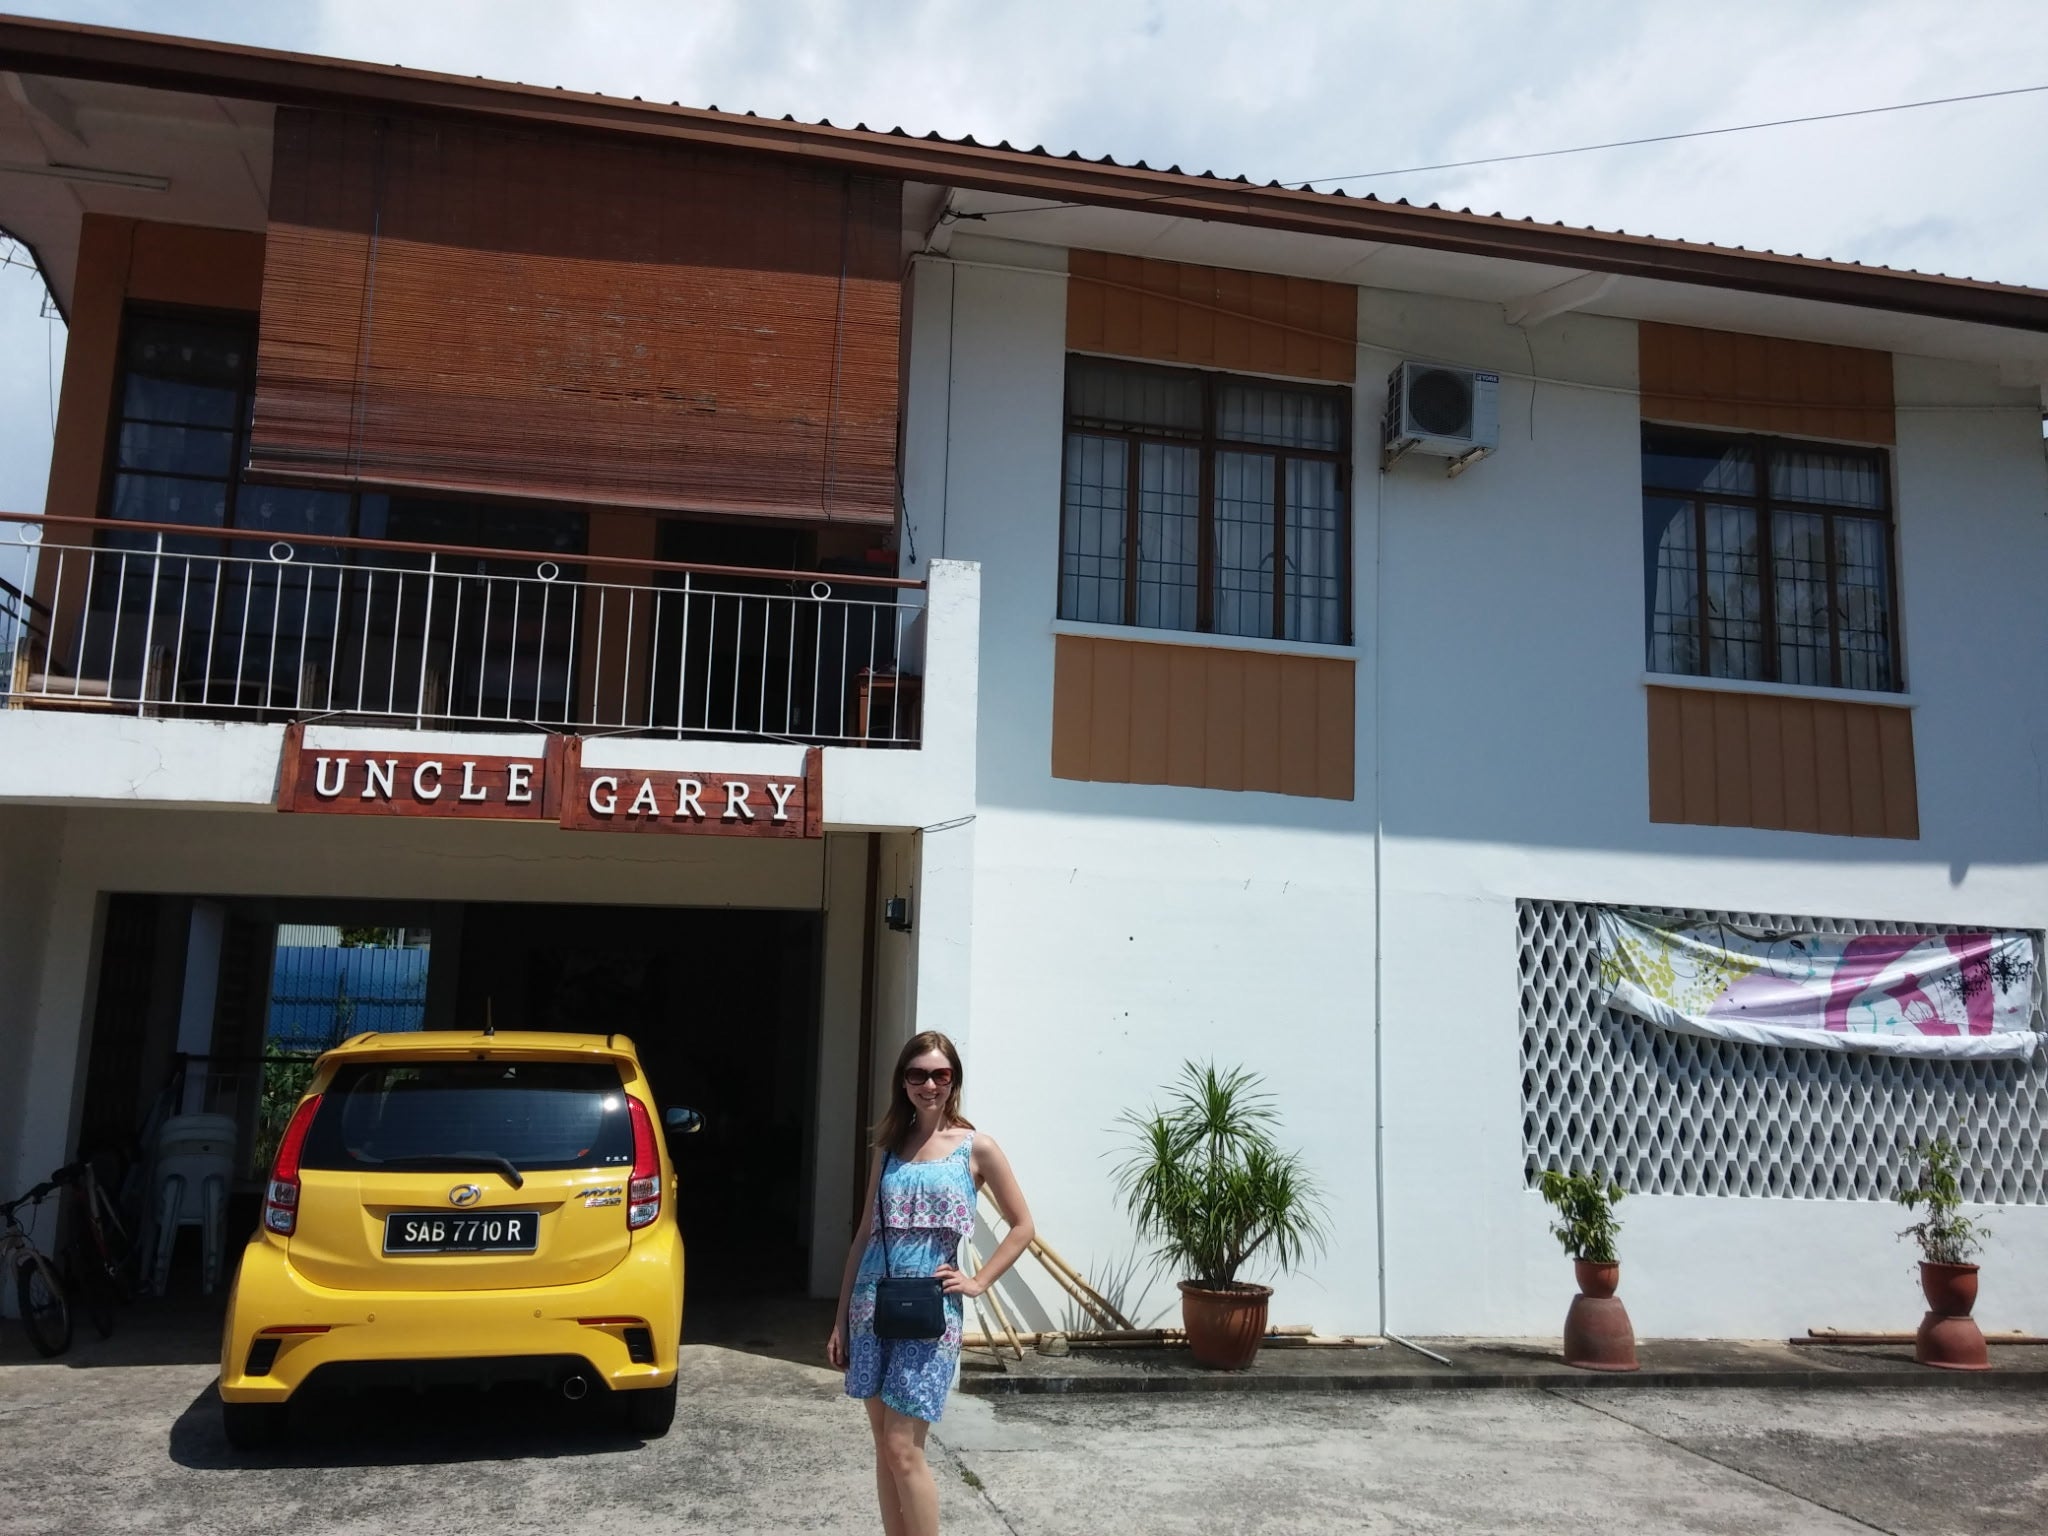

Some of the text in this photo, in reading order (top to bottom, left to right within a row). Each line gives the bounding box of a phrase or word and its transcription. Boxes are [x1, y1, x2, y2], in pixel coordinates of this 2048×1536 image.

[315, 757, 796, 820] UNCLE GARRY
[404, 1220, 521, 1242] SAB 7710 R
